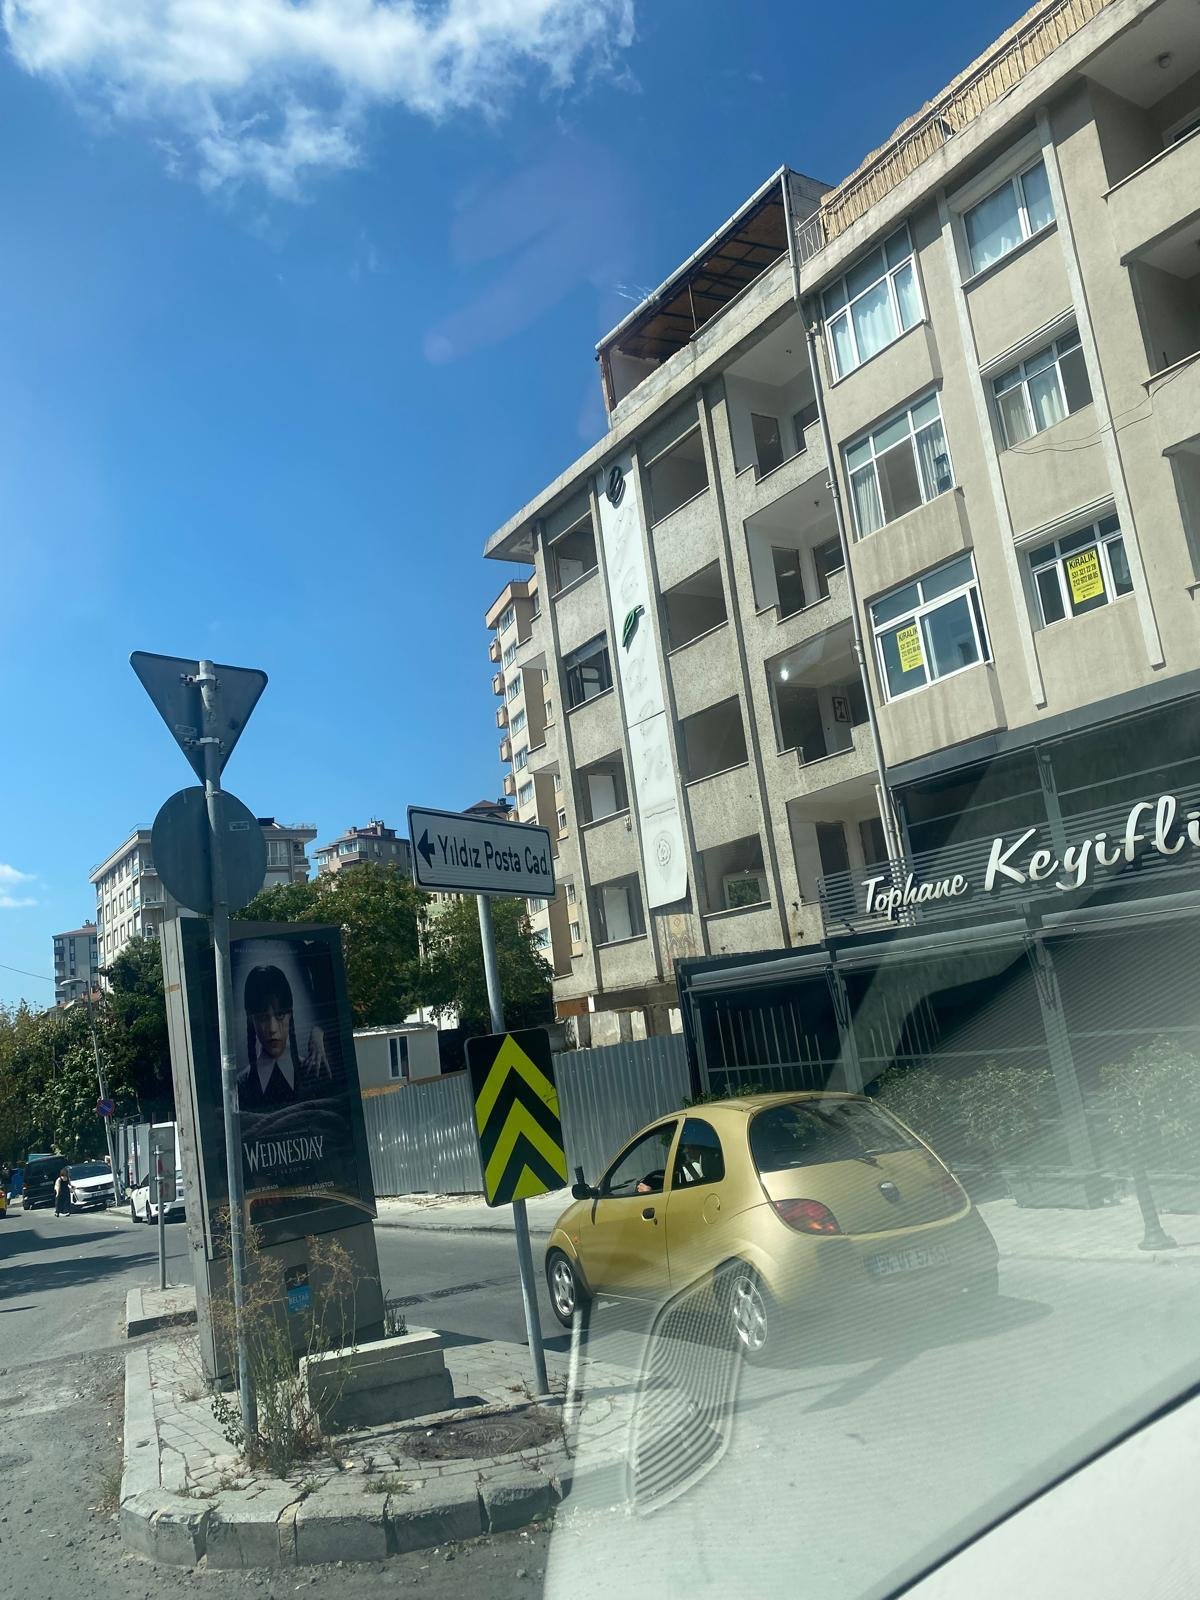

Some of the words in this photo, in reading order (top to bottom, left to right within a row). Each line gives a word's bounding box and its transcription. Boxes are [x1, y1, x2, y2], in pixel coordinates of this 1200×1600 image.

[437, 834, 482, 868] Yıldız
[484, 840, 522, 873] Posta
[524, 846, 551, 876] Cad.
[861, 872, 968, 921] Tophane
[243, 1135, 323, 1173] WEDNESDAY
